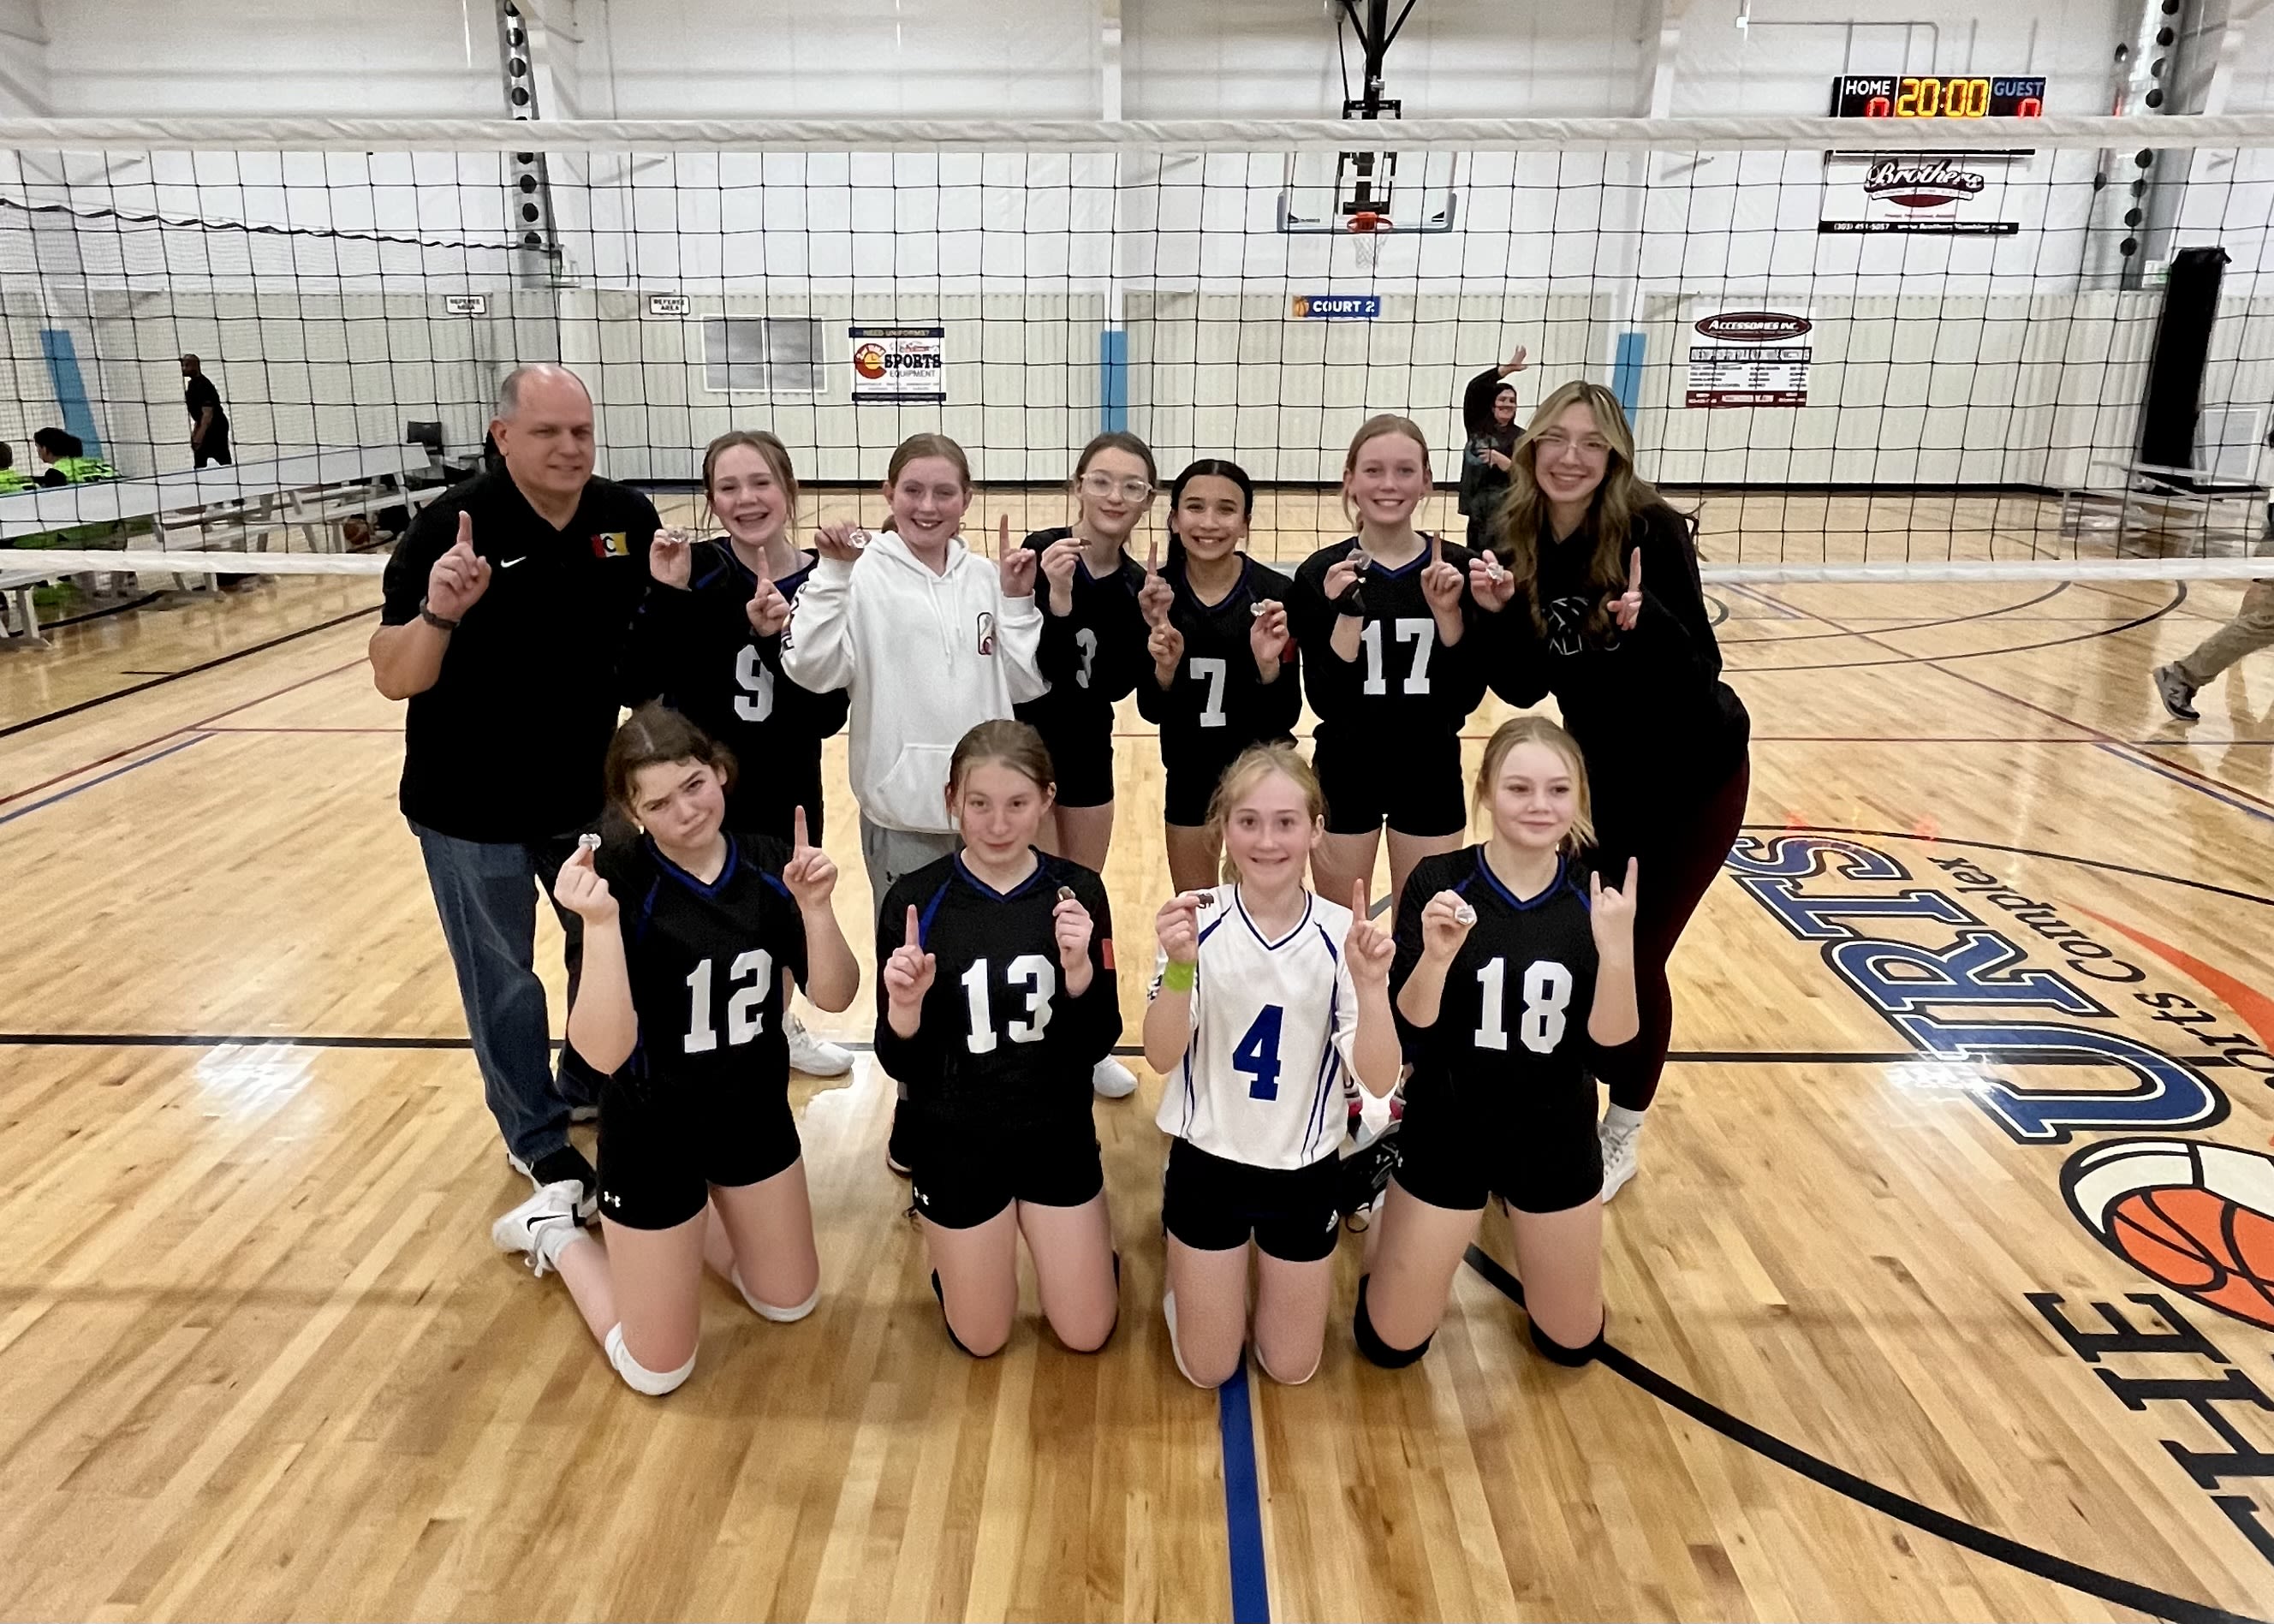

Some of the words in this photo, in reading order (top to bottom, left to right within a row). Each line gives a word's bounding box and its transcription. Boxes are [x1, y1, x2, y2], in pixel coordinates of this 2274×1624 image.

[1845, 80, 1890, 96] HOME
[1897, 78, 1988, 116] 20:00
[1994, 81, 2044, 97] GUEST
[1864, 161, 1984, 188] Brothers
[1313, 300, 1361, 312] COURT
[1365, 300, 1375, 312] 2
[1708, 319, 1779, 330] ACCESSORIES
[884, 354, 941, 368] SPORTS
[734, 644, 774, 722] 9
[1360, 617, 1435, 695] 17
[1189, 657, 1227, 728] 7
[1926, 856, 2146, 983] Complex
[684, 949, 771, 1054] 12
[961, 955, 1055, 1054] 13
[1474, 957, 1574, 1055] 18
[1232, 1004, 1284, 1102] 4
